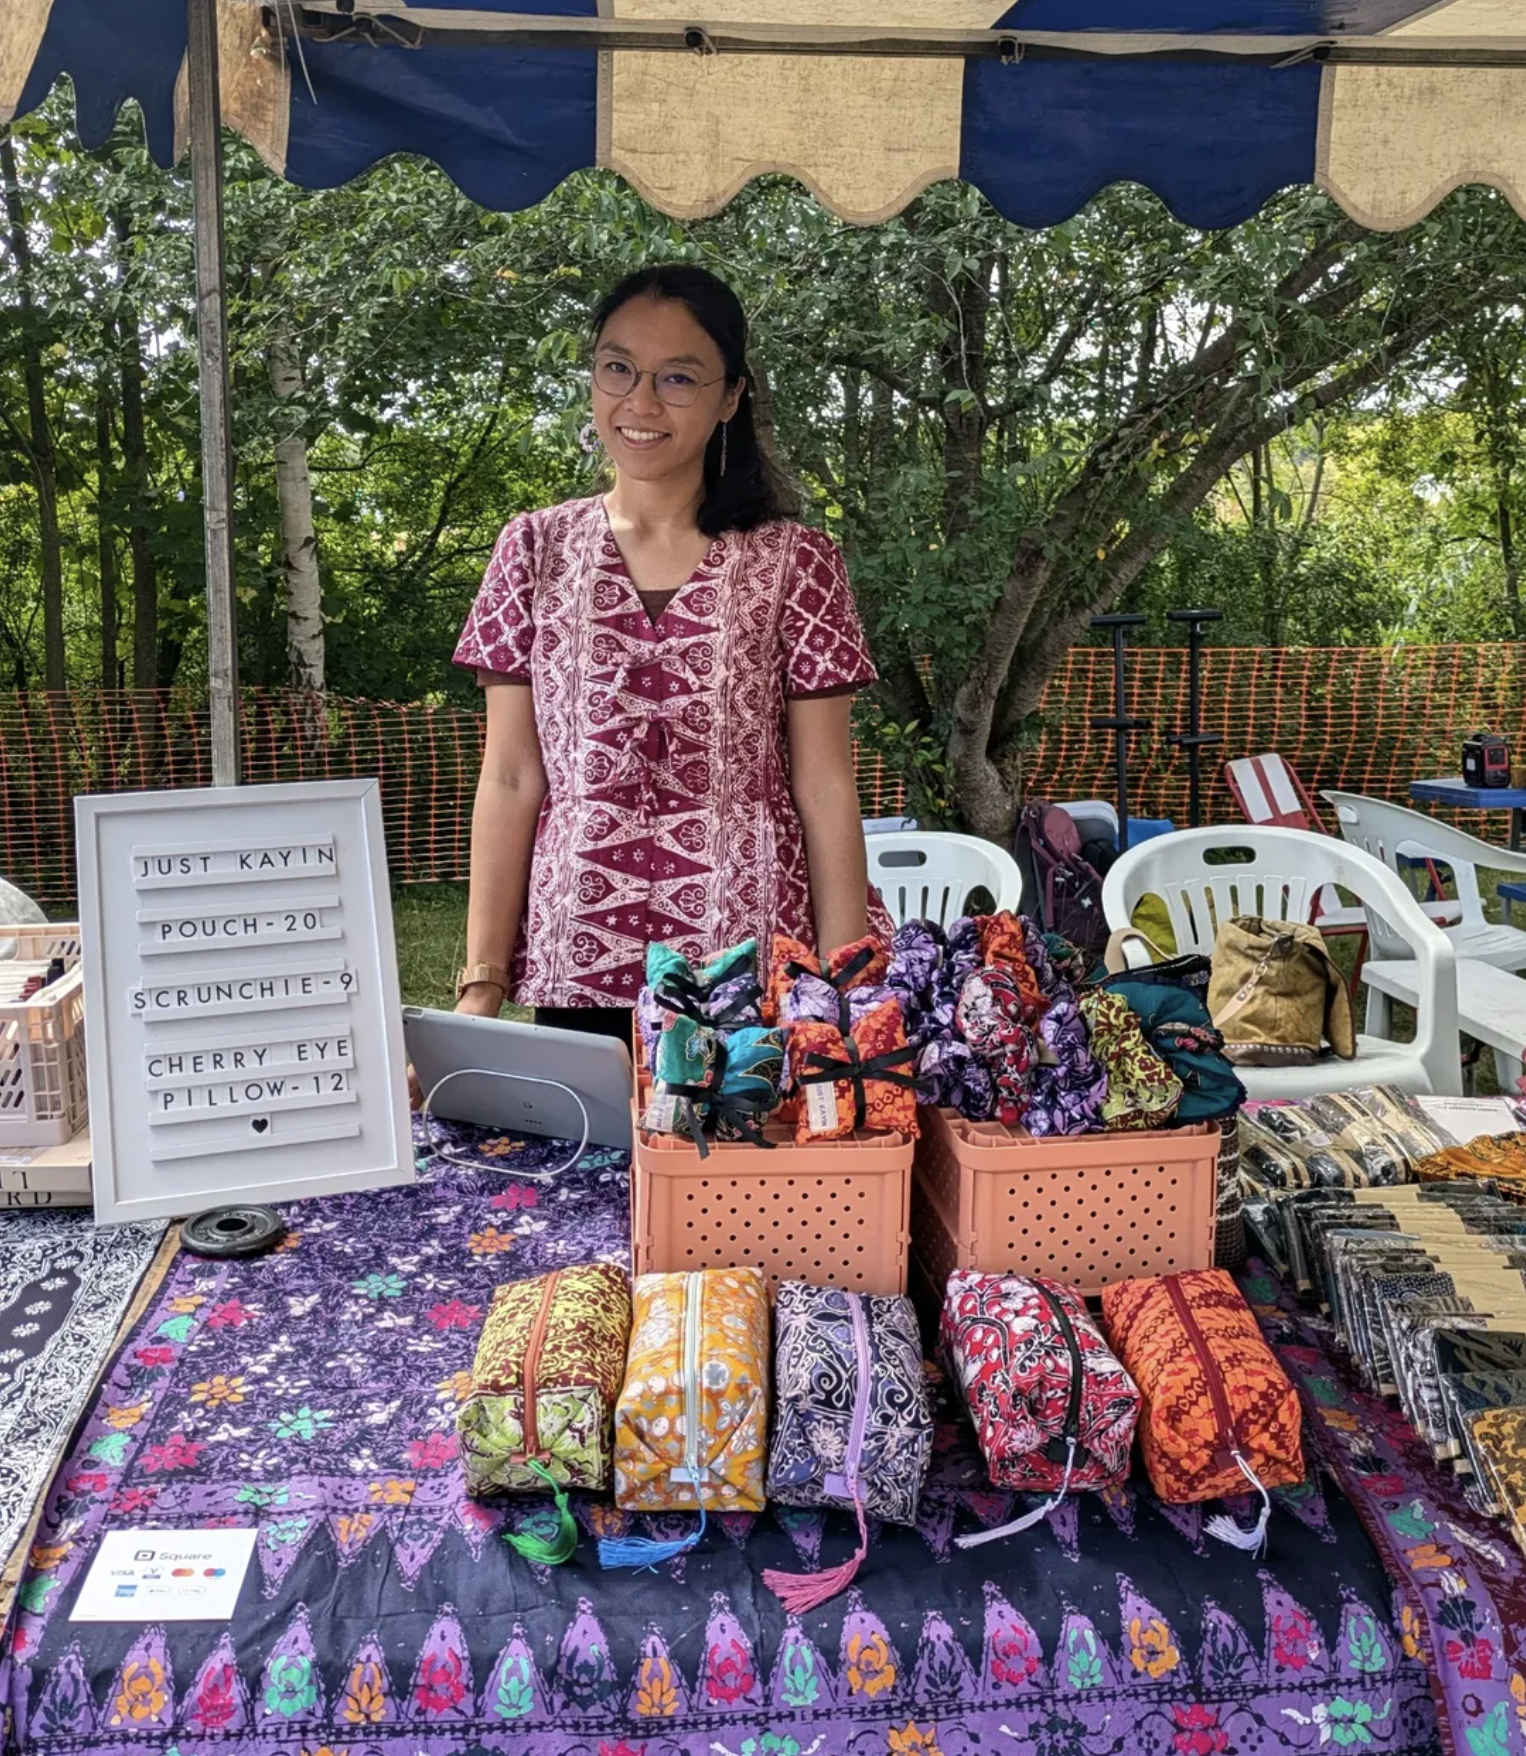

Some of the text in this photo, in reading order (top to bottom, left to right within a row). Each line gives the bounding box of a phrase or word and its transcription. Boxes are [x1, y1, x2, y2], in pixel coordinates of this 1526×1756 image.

[140, 846, 335, 878] JUST KAYIN
[161, 912, 318, 941] POUCH-20
[134, 972, 354, 1010] SCRUNCHIE-9
[148, 1039, 349, 1078] CHERRY EYE
[163, 1072, 345, 1111] PILLOW-12
[159, 1551, 213, 1562] Square
